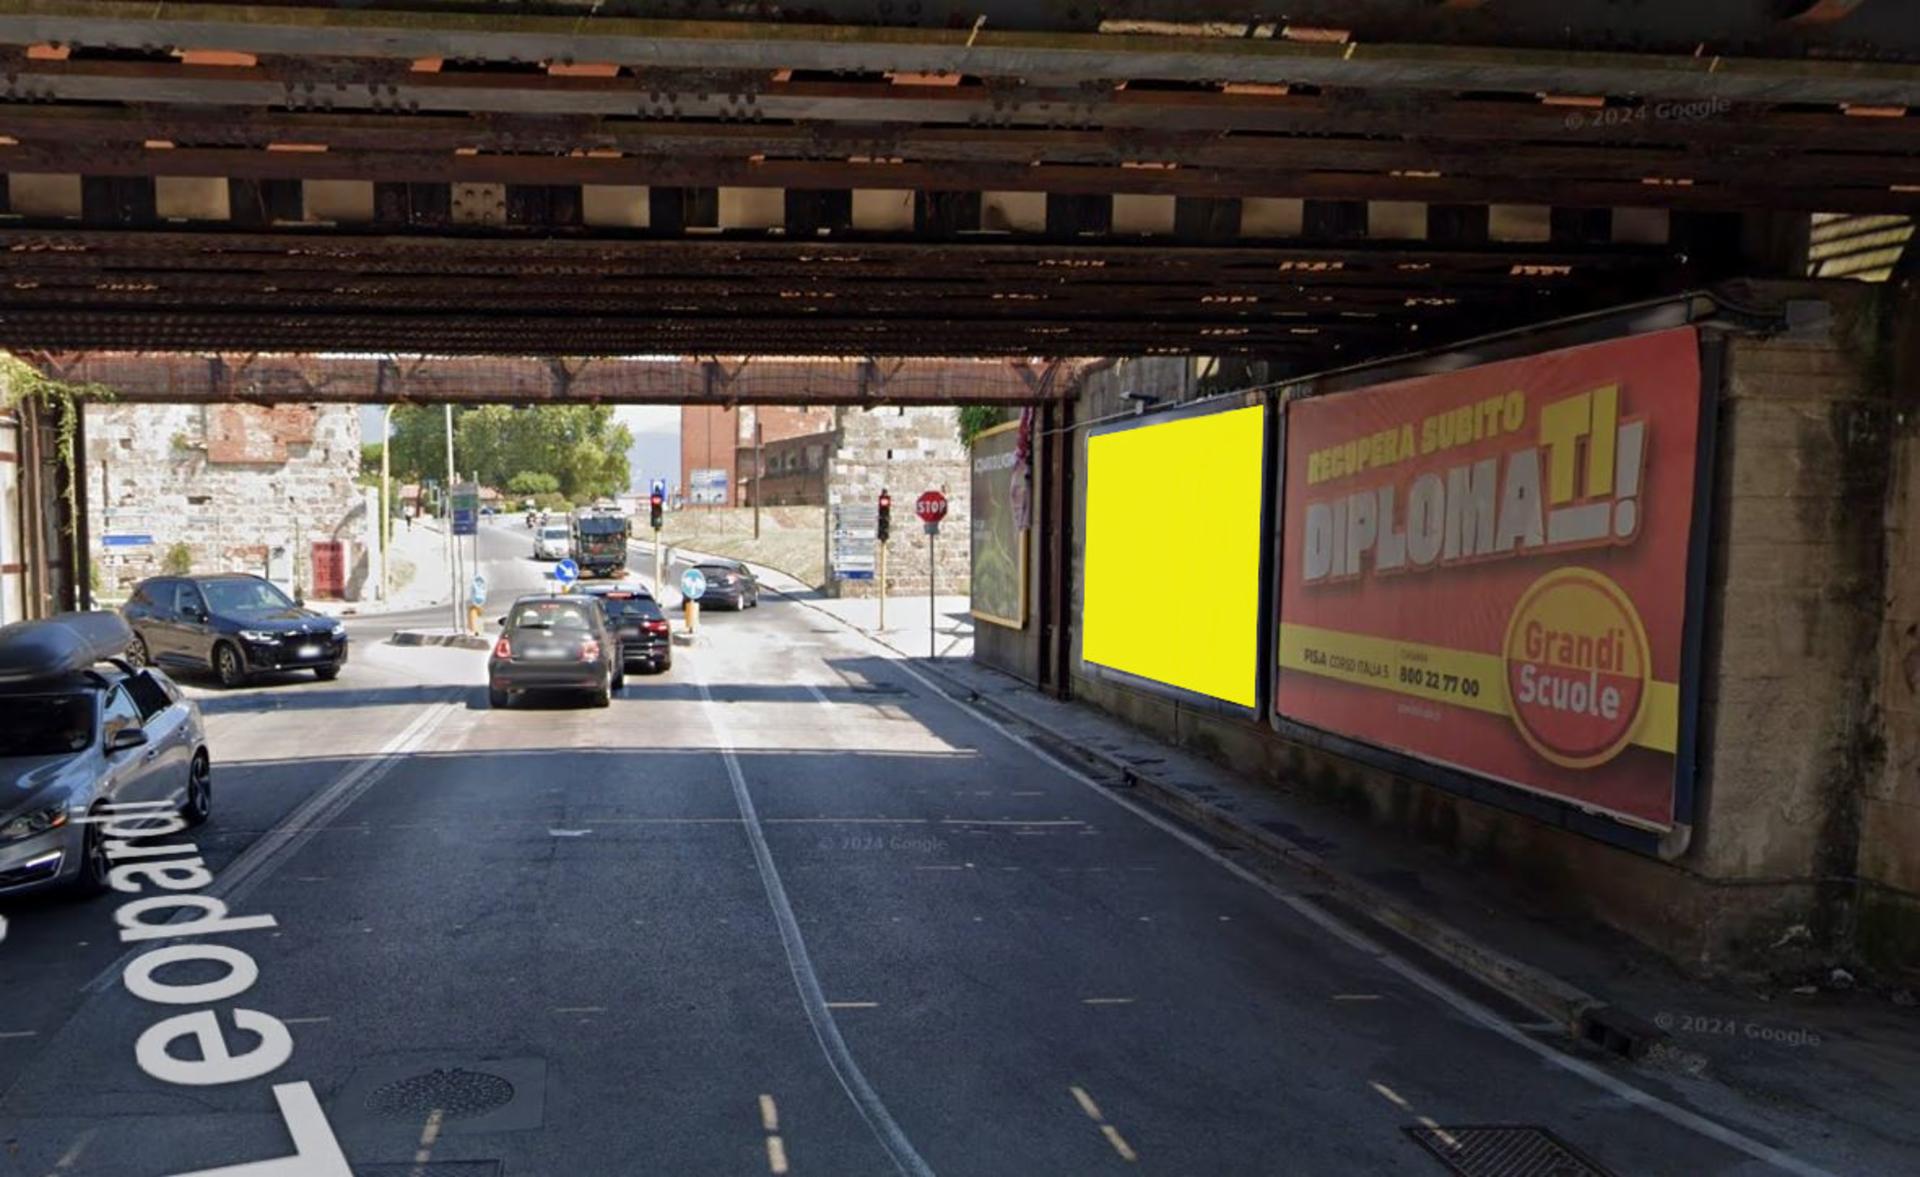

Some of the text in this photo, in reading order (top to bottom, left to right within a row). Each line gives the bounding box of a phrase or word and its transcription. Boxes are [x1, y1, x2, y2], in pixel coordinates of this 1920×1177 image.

[1307, 391, 1525, 486] RECUPERA SUBITO
[917, 499, 946, 515] STOP
[1524, 619, 1625, 673] Grandi
[1400, 665, 1481, 698] 800 22 77 00
[1519, 662, 1621, 720] Scuole
